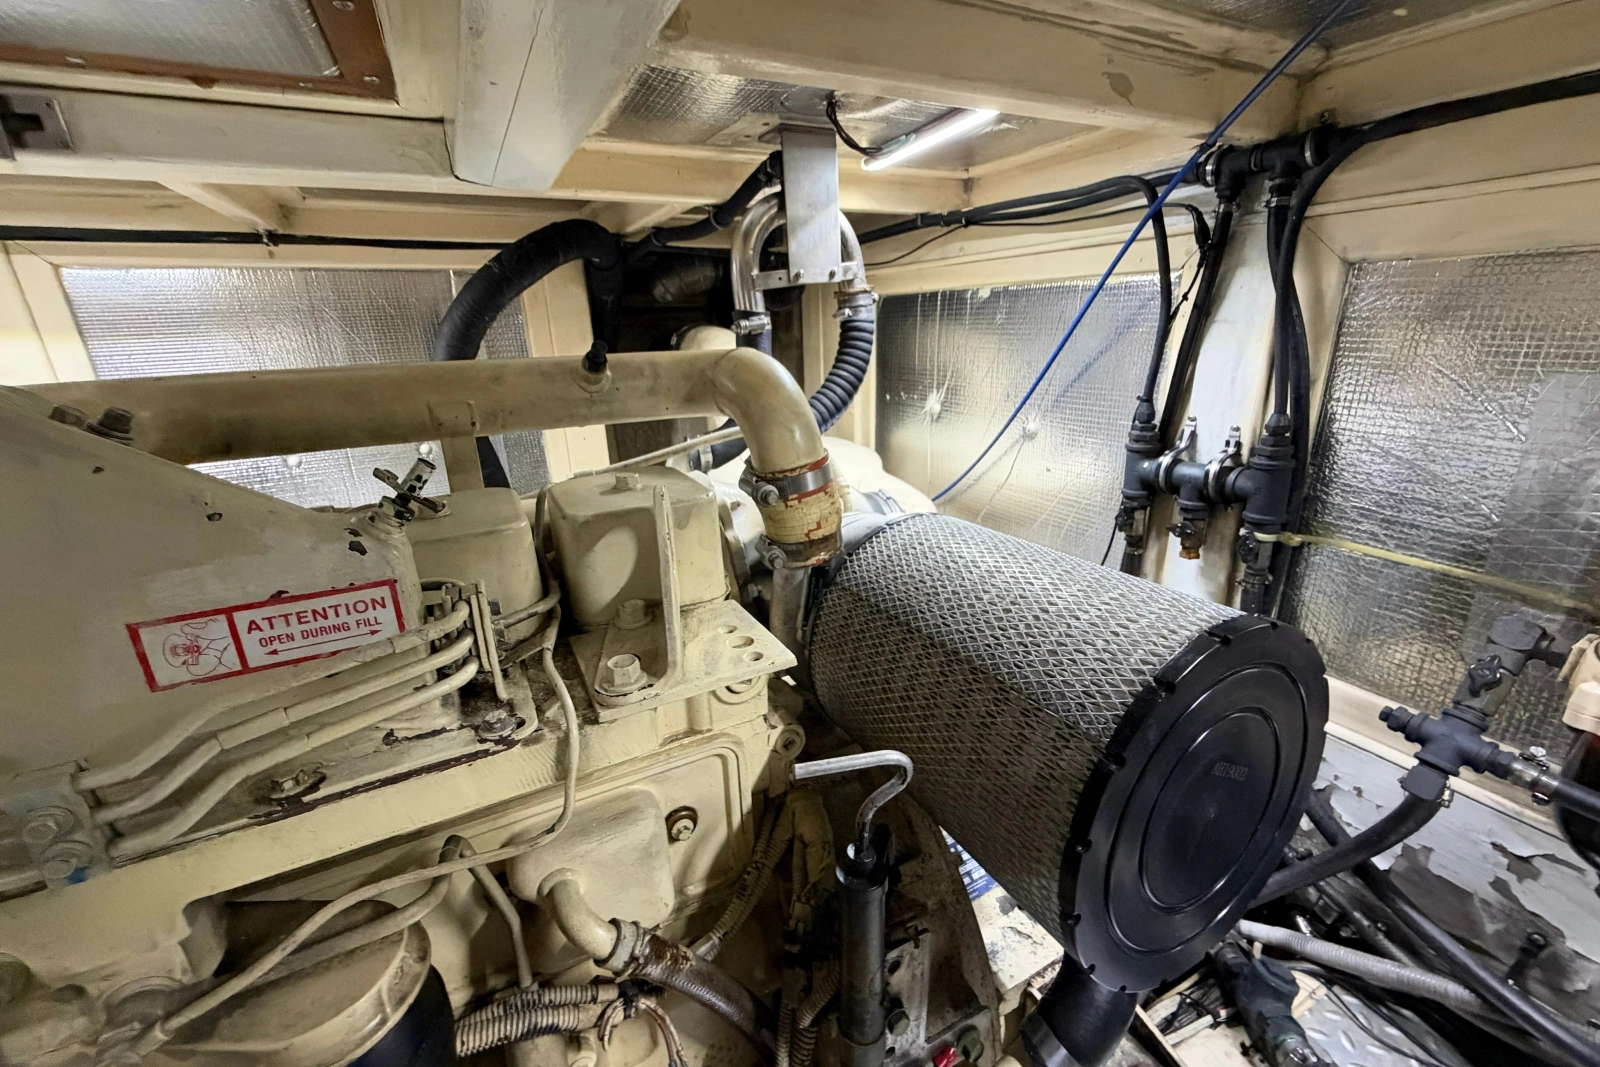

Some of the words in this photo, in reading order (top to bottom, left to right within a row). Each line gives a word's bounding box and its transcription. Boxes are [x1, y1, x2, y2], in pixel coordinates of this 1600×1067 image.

[246, 596, 387, 634] ATTENTION
[259, 633, 295, 648] OPEN
[301, 621, 351, 640] DURING
[356, 616, 382, 629] FILL
